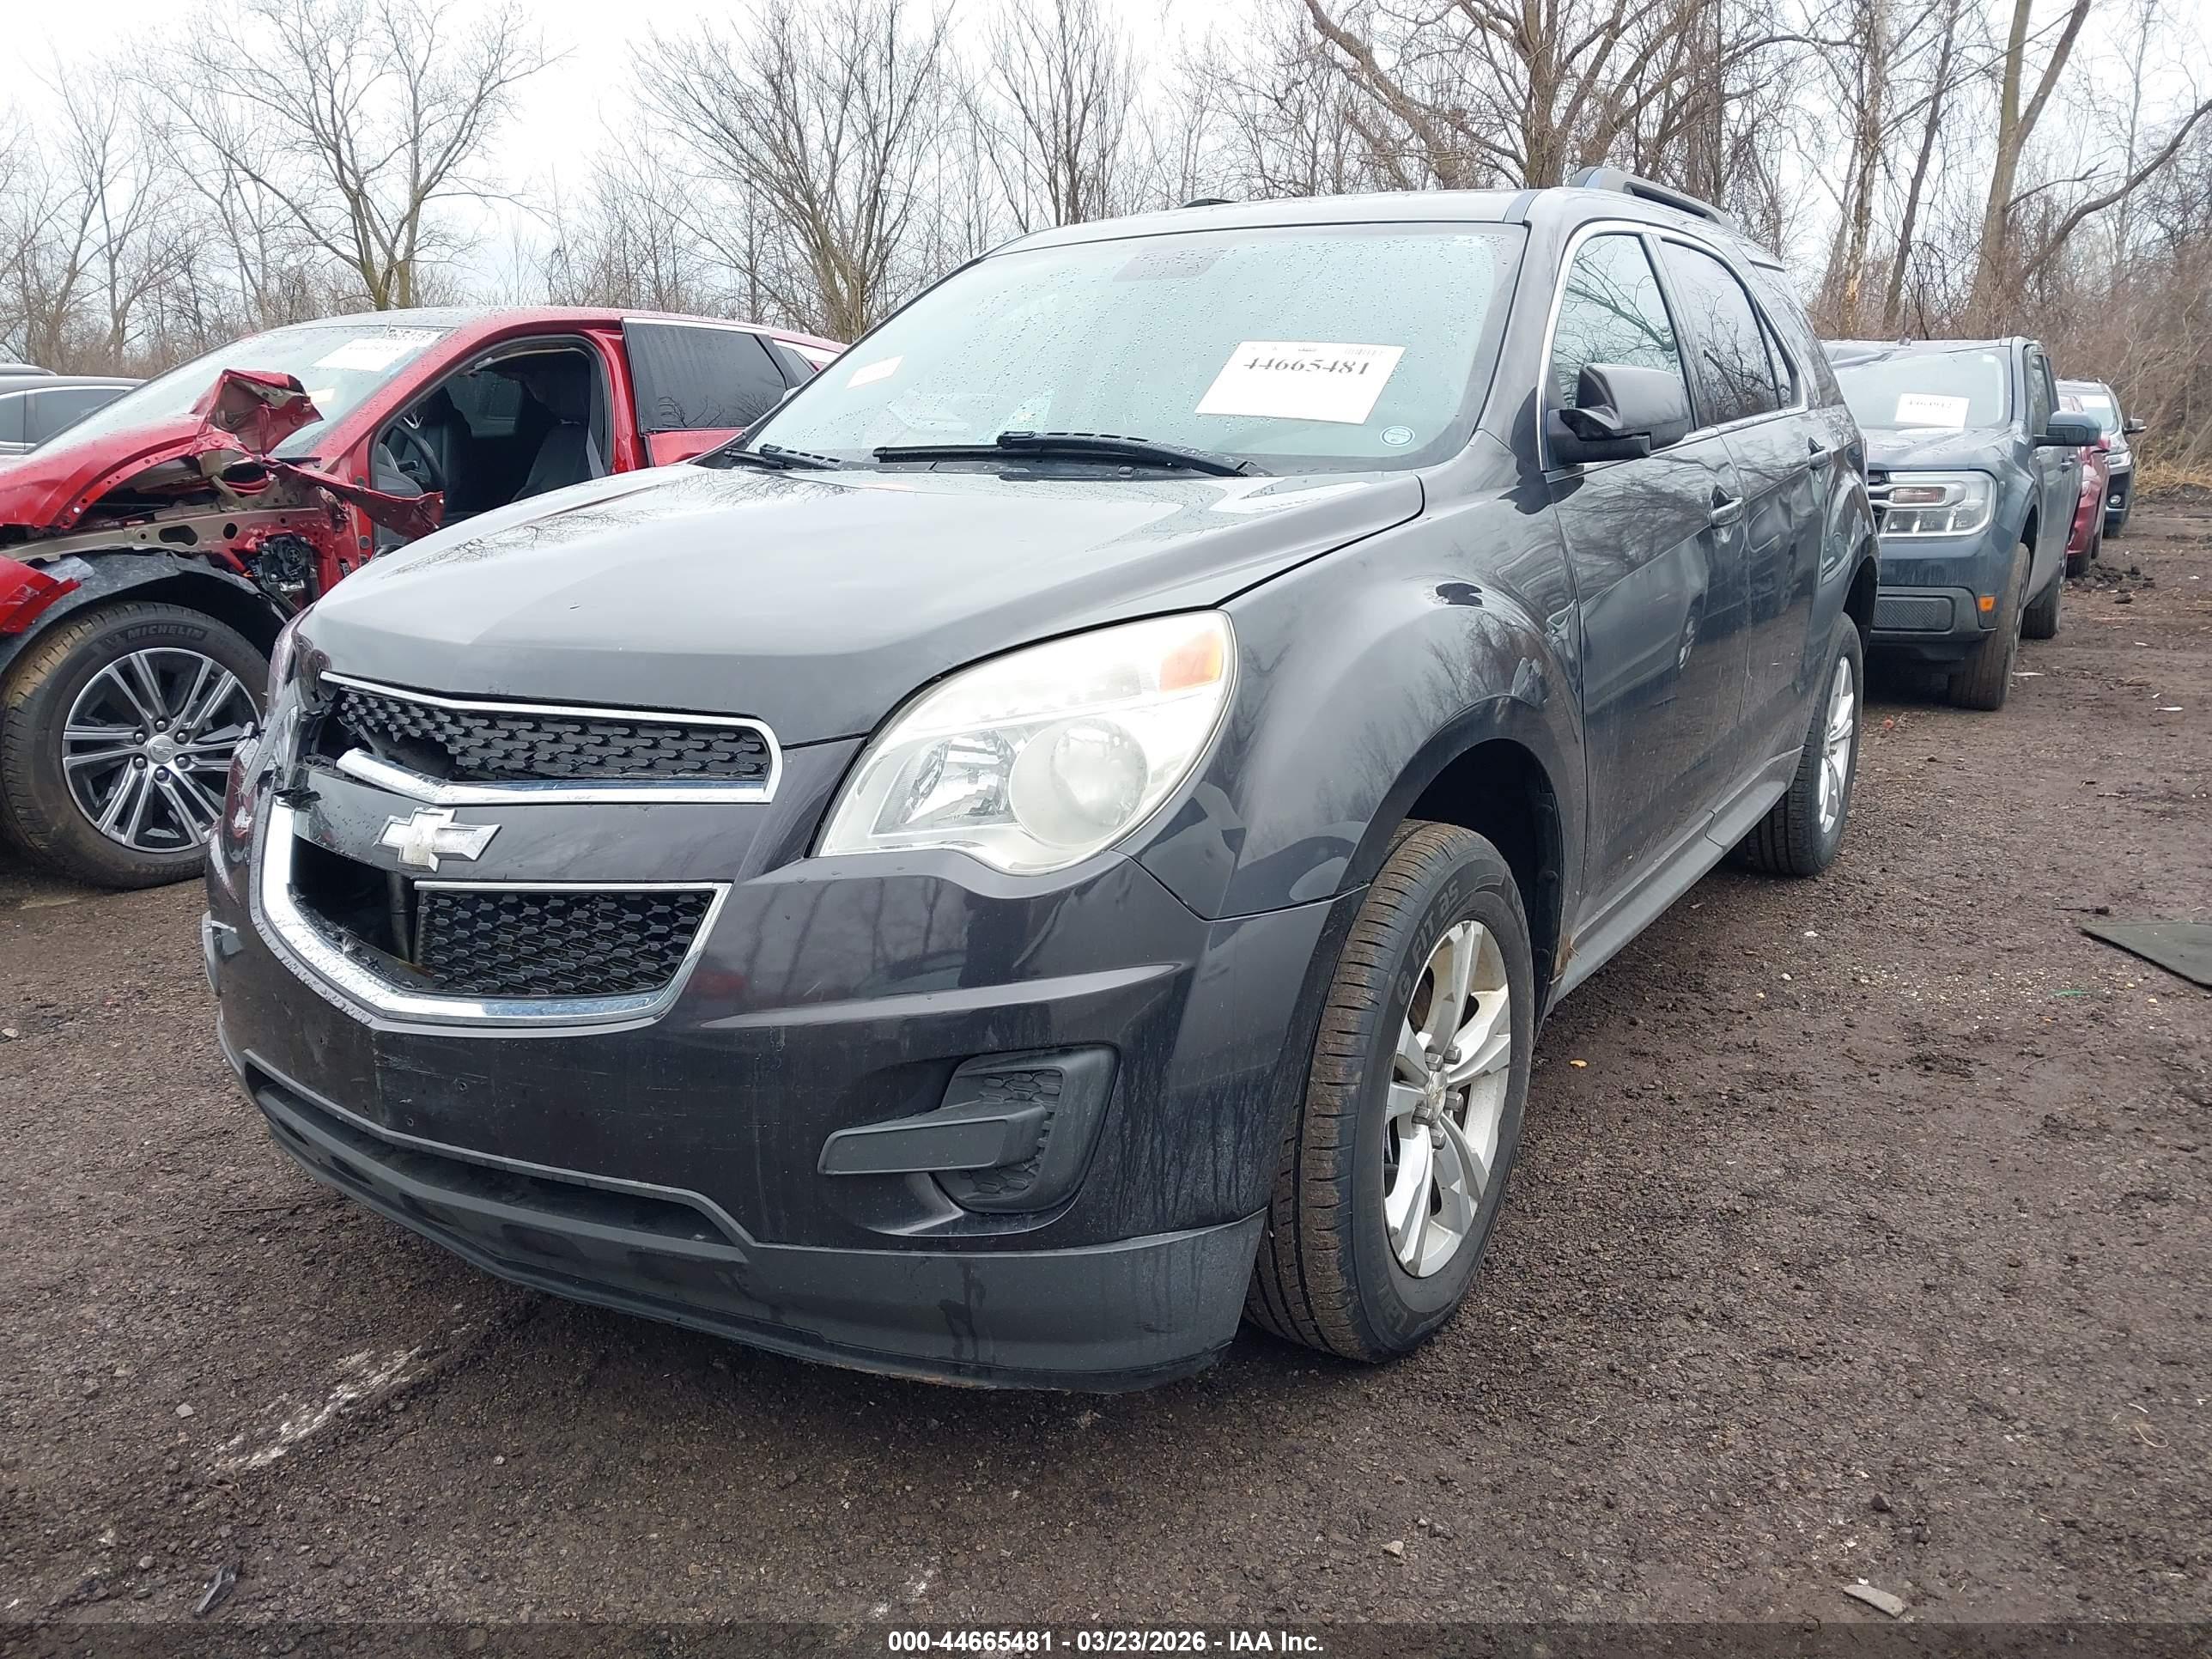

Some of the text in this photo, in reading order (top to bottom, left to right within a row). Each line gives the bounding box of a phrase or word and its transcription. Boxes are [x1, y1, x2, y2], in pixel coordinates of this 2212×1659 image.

[1243, 356, 1370, 376] 44665481
[128, 624, 205, 641] MICHELIN
[1412, 912, 1435, 965] FIT
